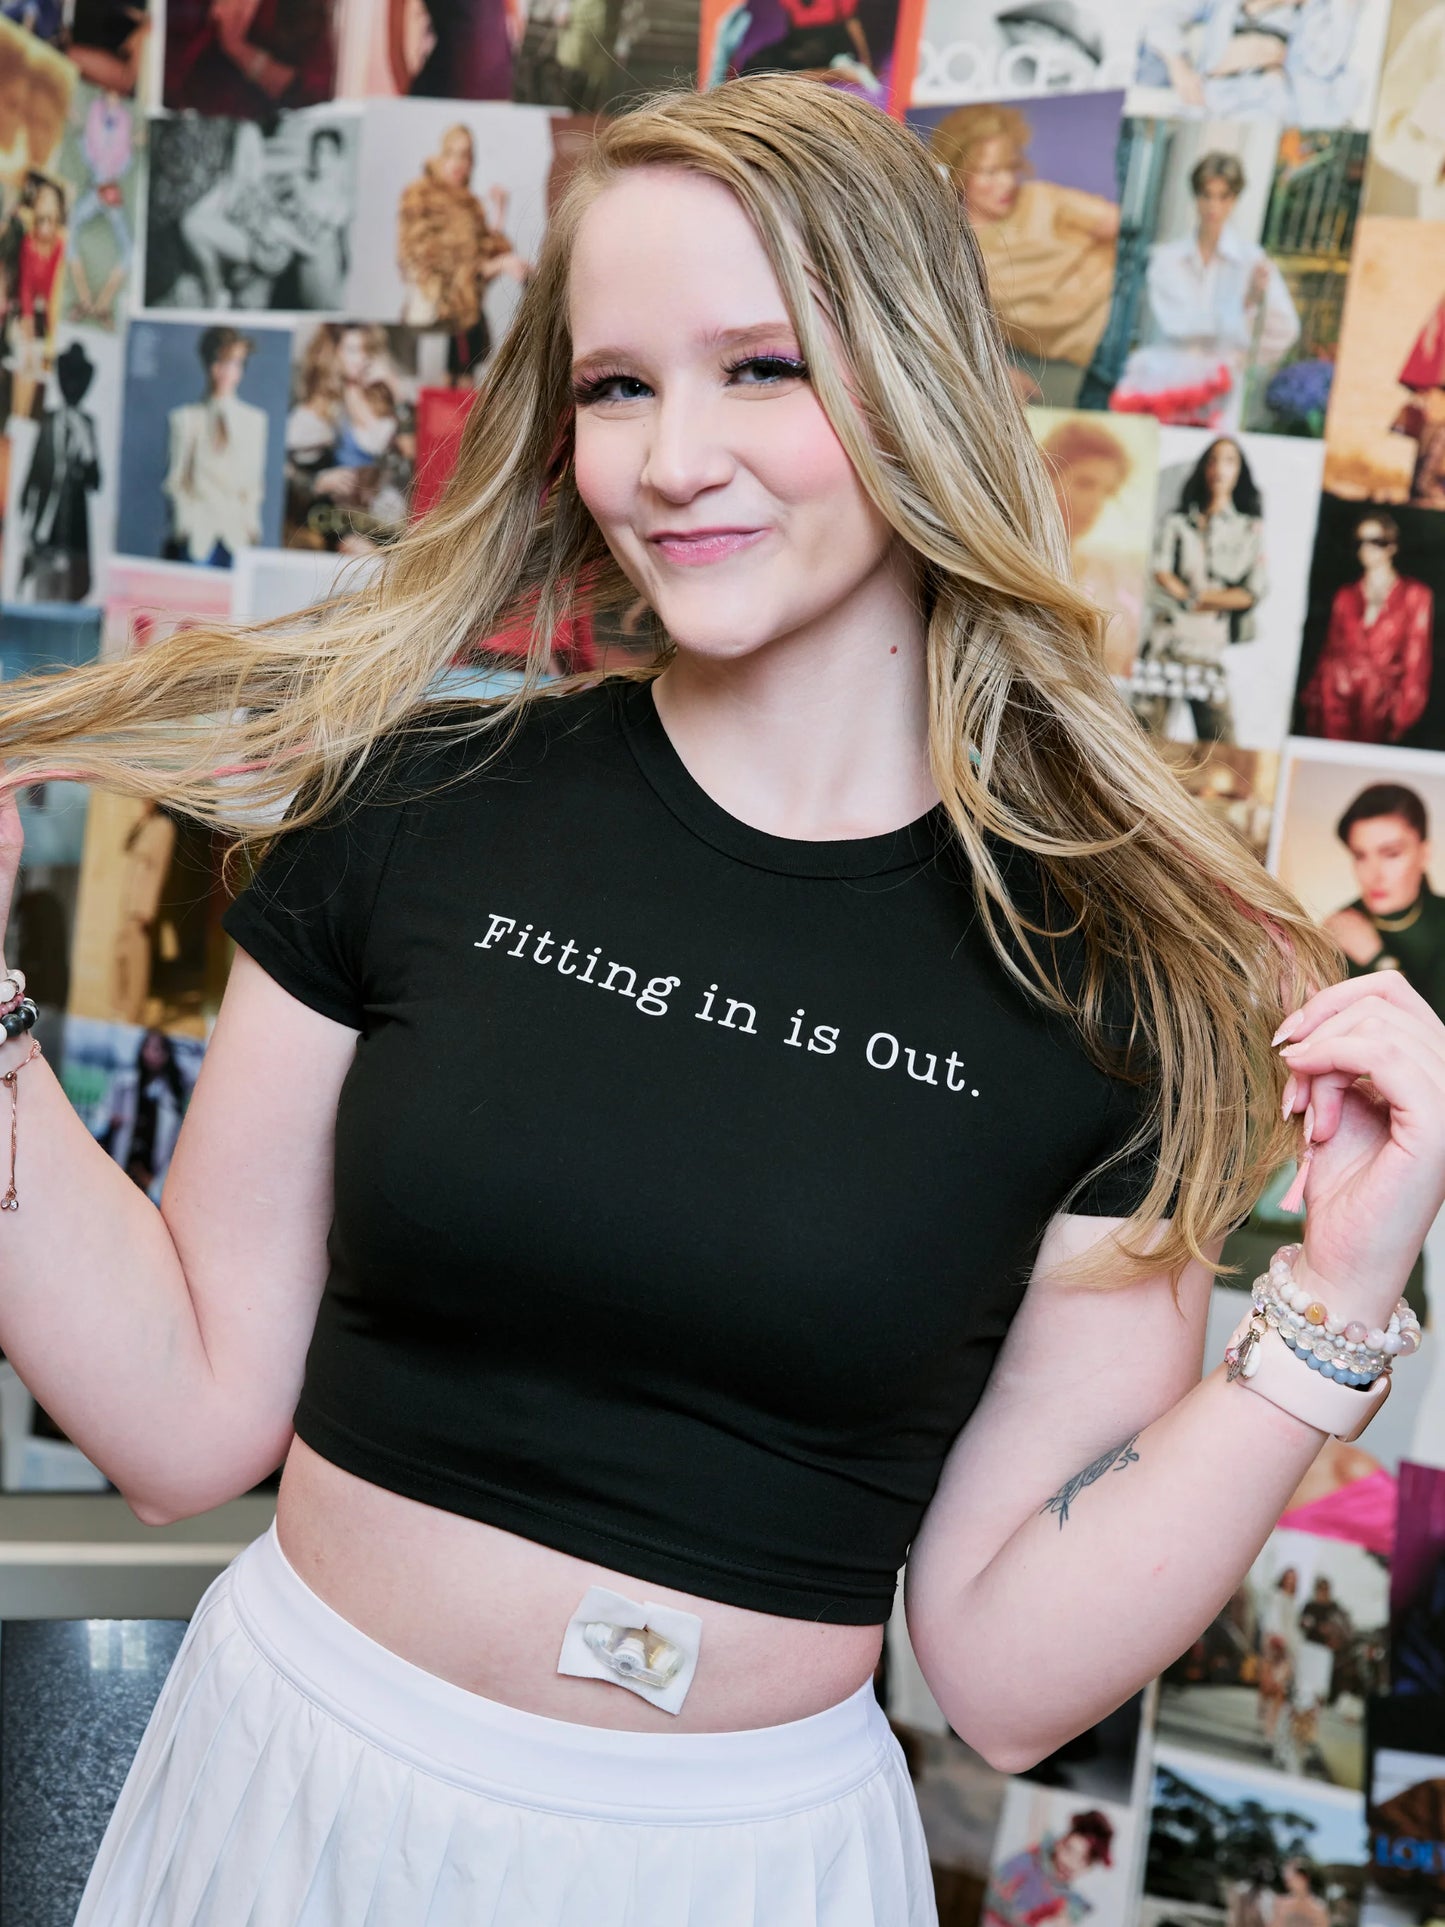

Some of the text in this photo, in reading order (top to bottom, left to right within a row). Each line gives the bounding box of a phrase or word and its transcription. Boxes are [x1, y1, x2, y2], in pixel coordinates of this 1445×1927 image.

[473, 913, 981, 1098] Fitting in is Out.
